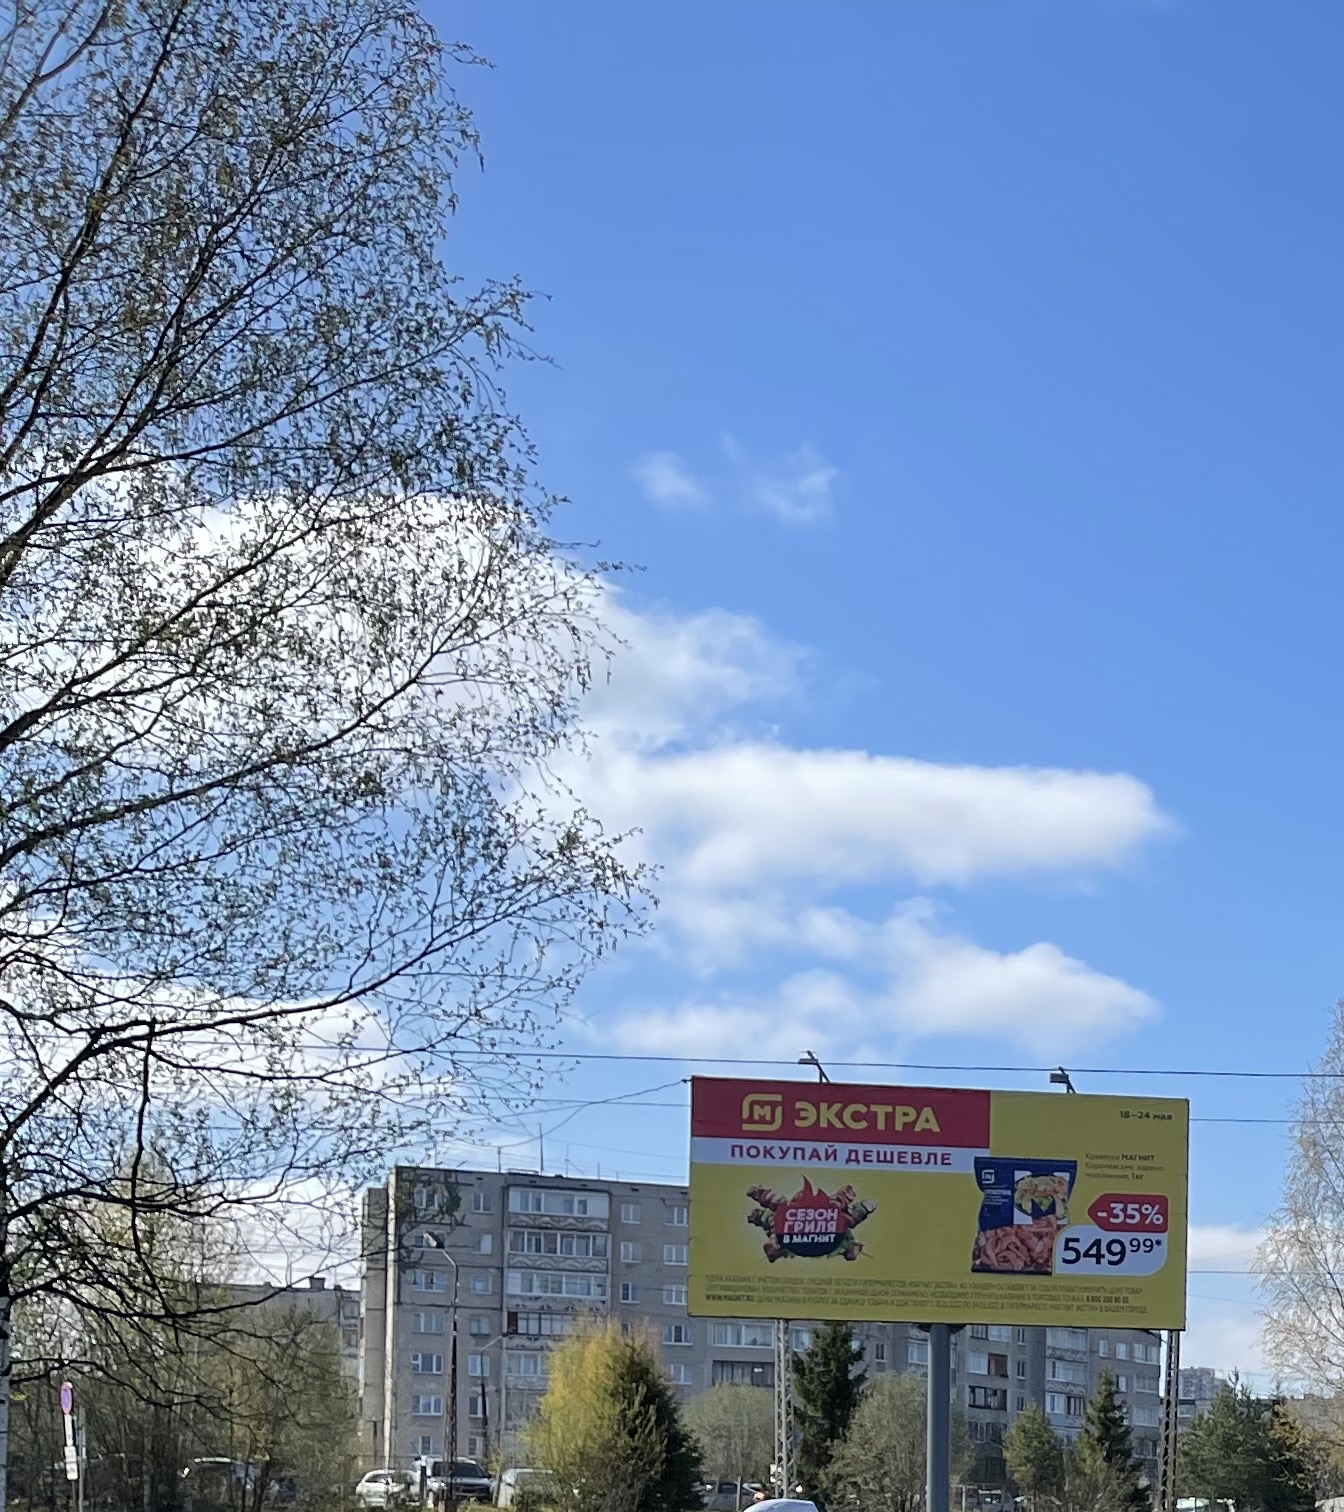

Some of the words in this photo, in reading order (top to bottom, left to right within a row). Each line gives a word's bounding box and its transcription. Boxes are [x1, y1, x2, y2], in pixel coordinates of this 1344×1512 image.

[794, 1101, 941, 1133] ЭКСТРА
[1152, 1113, 1173, 1121] мая
[730, 1143, 838, 1162] ПОКУПАЙ
[845, 1149, 952, 1166] ДЕШЕВЛЕ
[1121, 1153, 1155, 1161] МАГНИТ
[785, 1208, 838, 1221] СЕЗОН
[1097, 1202, 1163, 1225] -35%
[783, 1220, 837, 1233] ГРИЛЯ
[783, 1234, 791, 1243] В
[792, 1233, 836, 1243] МАГНИТ
[1061, 1237, 1126, 1266] 549
